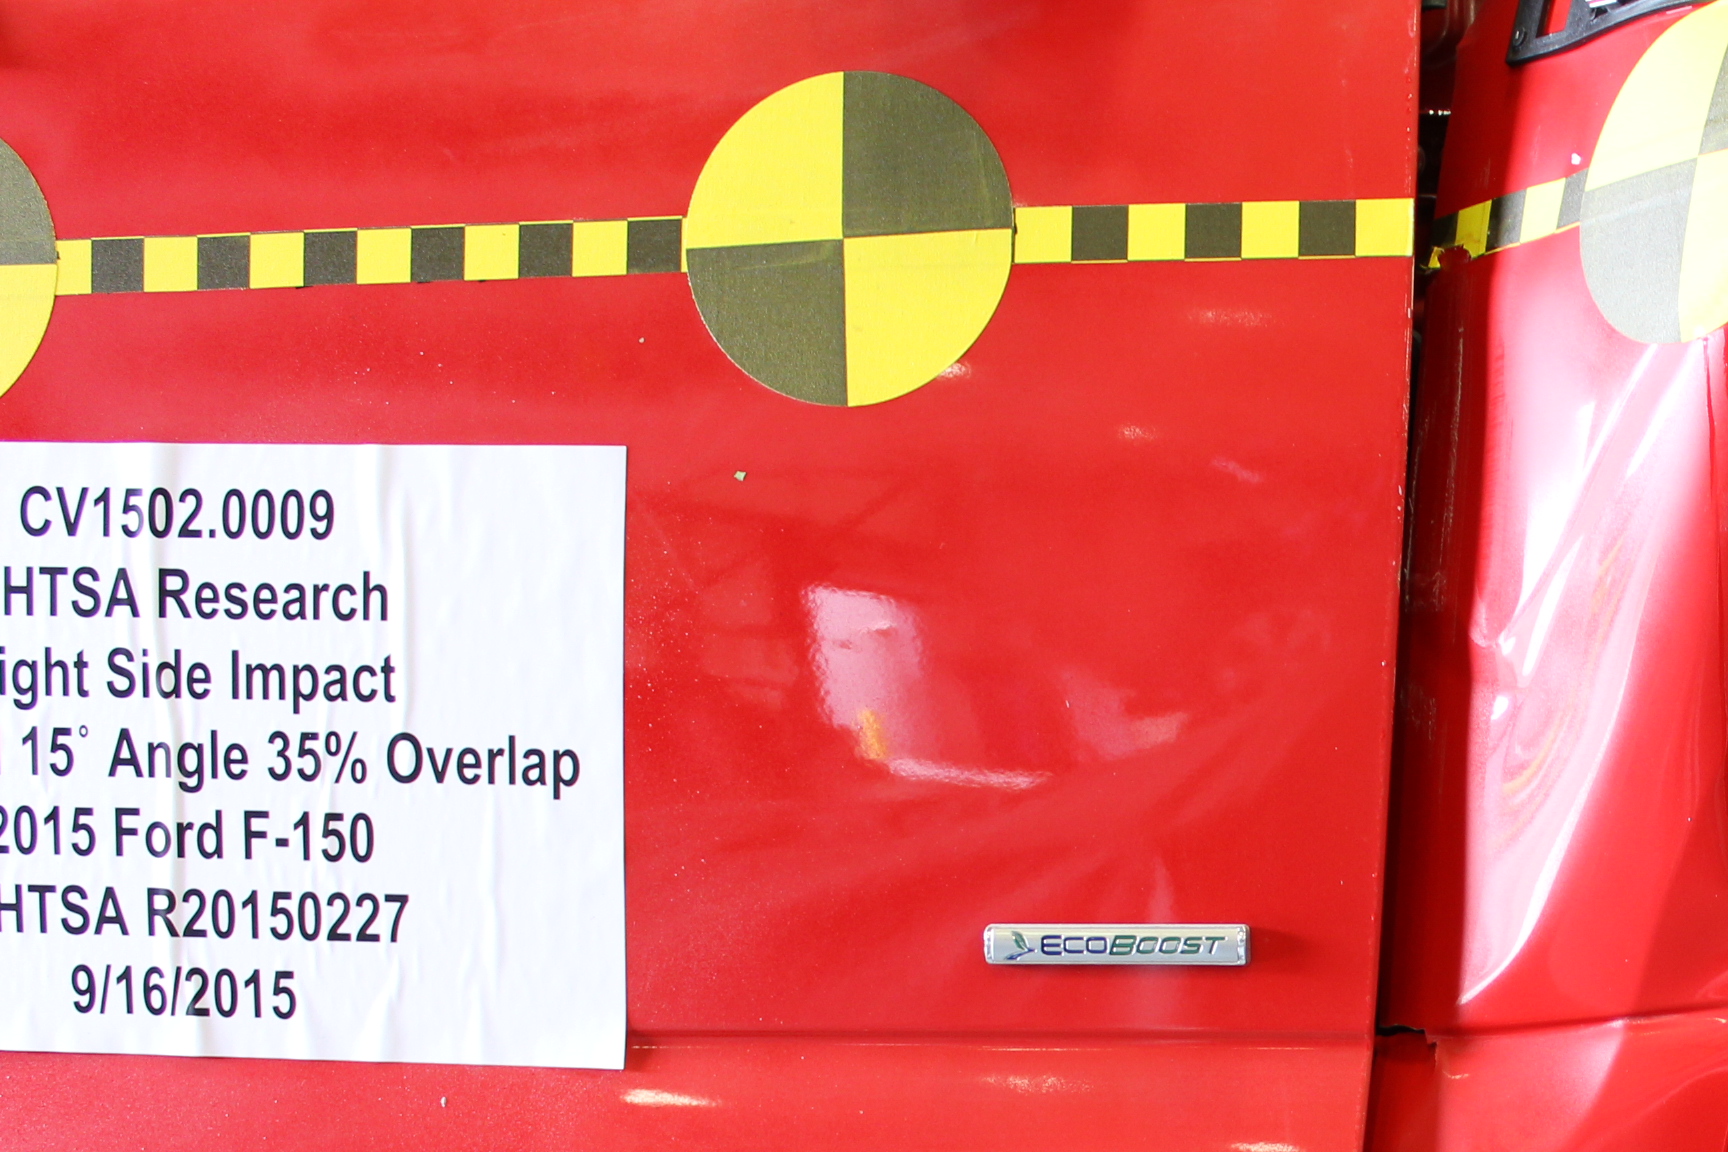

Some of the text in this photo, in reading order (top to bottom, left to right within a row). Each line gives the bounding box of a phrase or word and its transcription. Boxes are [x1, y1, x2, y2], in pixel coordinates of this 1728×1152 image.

[20, 485, 335, 541] CV1502.0009
[4, 566, 388, 622] HTSA Research
[106, 647, 212, 700] Side
[231, 650, 396, 715] Impact
[108, 728, 249, 794] Angle
[267, 731, 368, 784] 35%
[387, 733, 580, 800] Overlap
[114, 808, 223, 860] Ford
[243, 810, 374, 863] F-150
[147, 887, 409, 943] R20150227
[71, 964, 297, 1020] 9/16/2015
